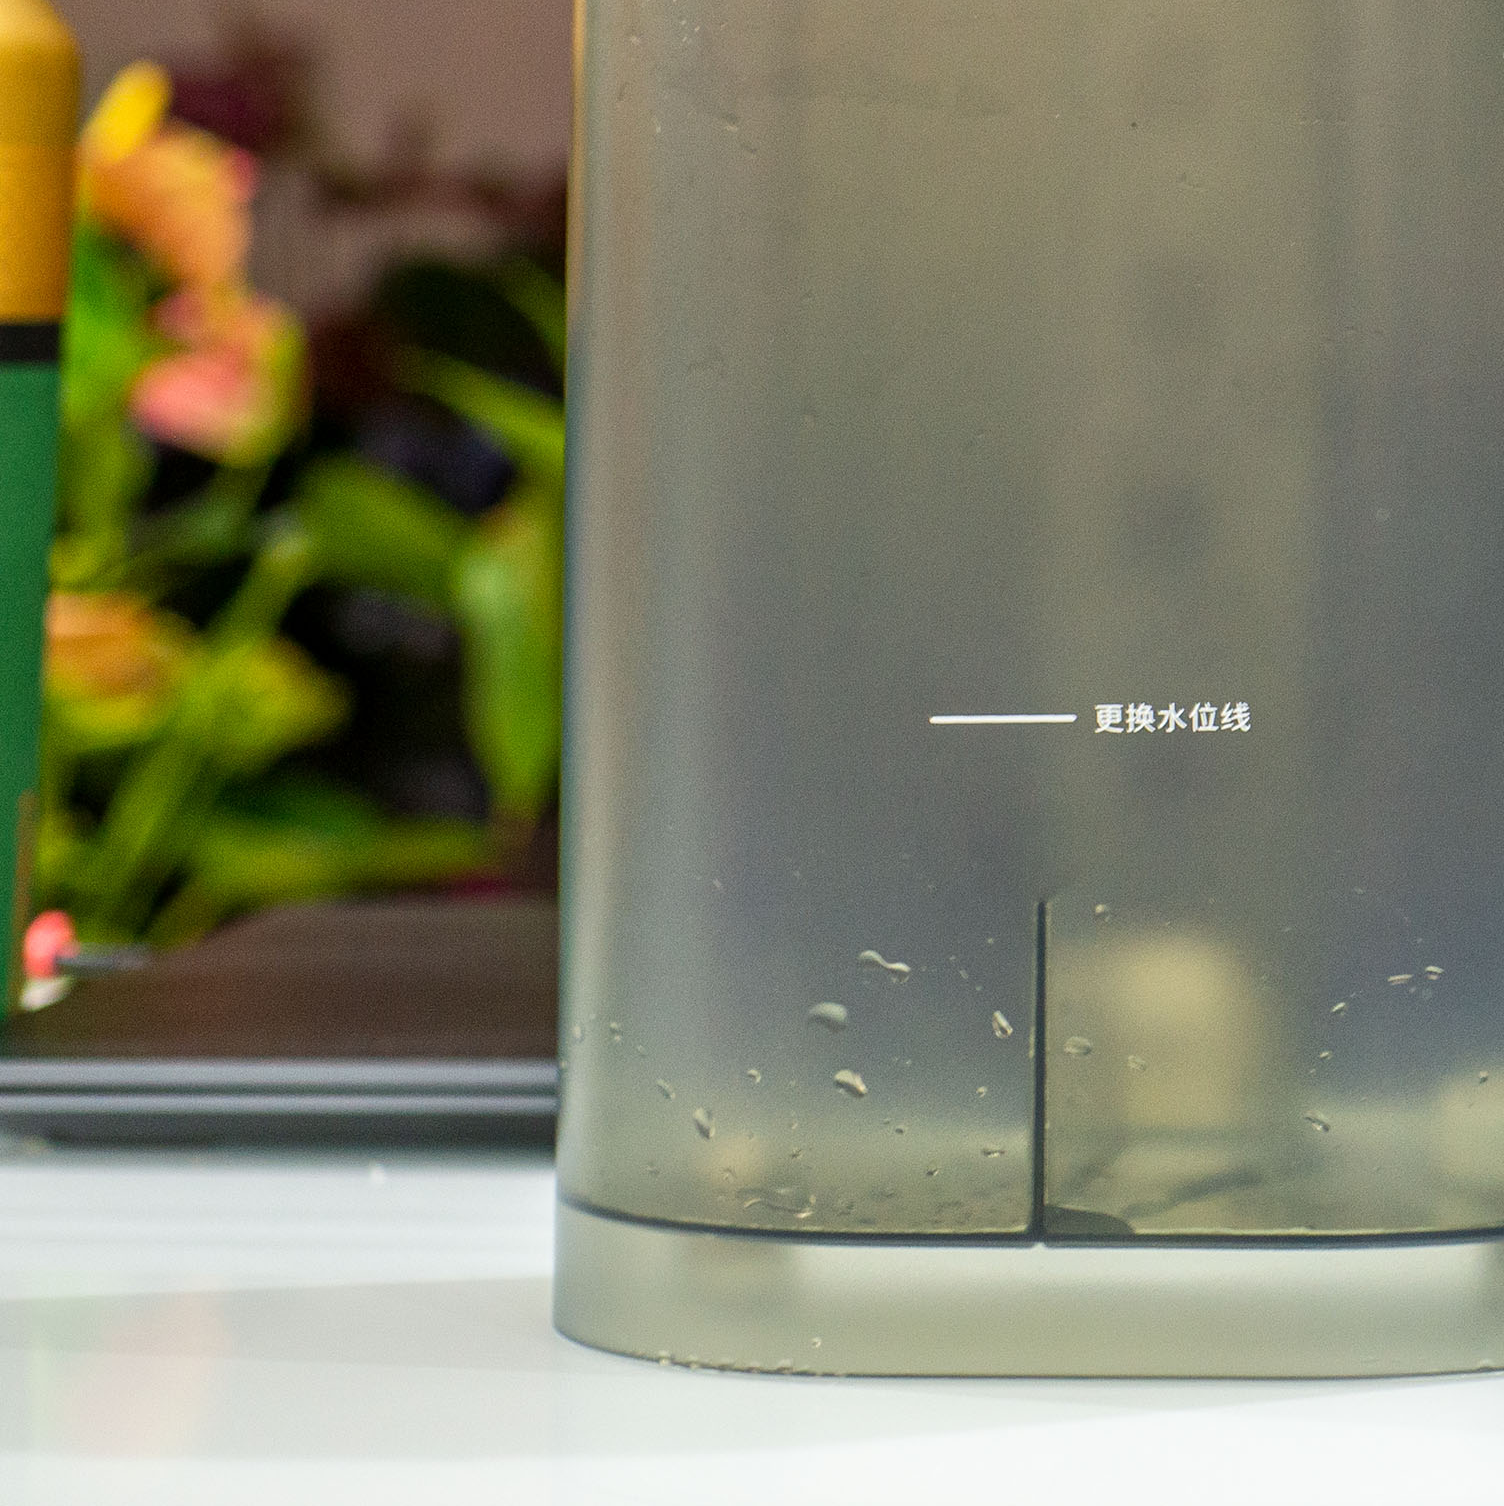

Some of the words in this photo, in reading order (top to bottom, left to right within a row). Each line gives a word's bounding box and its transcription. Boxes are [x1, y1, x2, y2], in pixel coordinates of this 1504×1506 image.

[1094, 701, 1251, 734] 更换水位线
